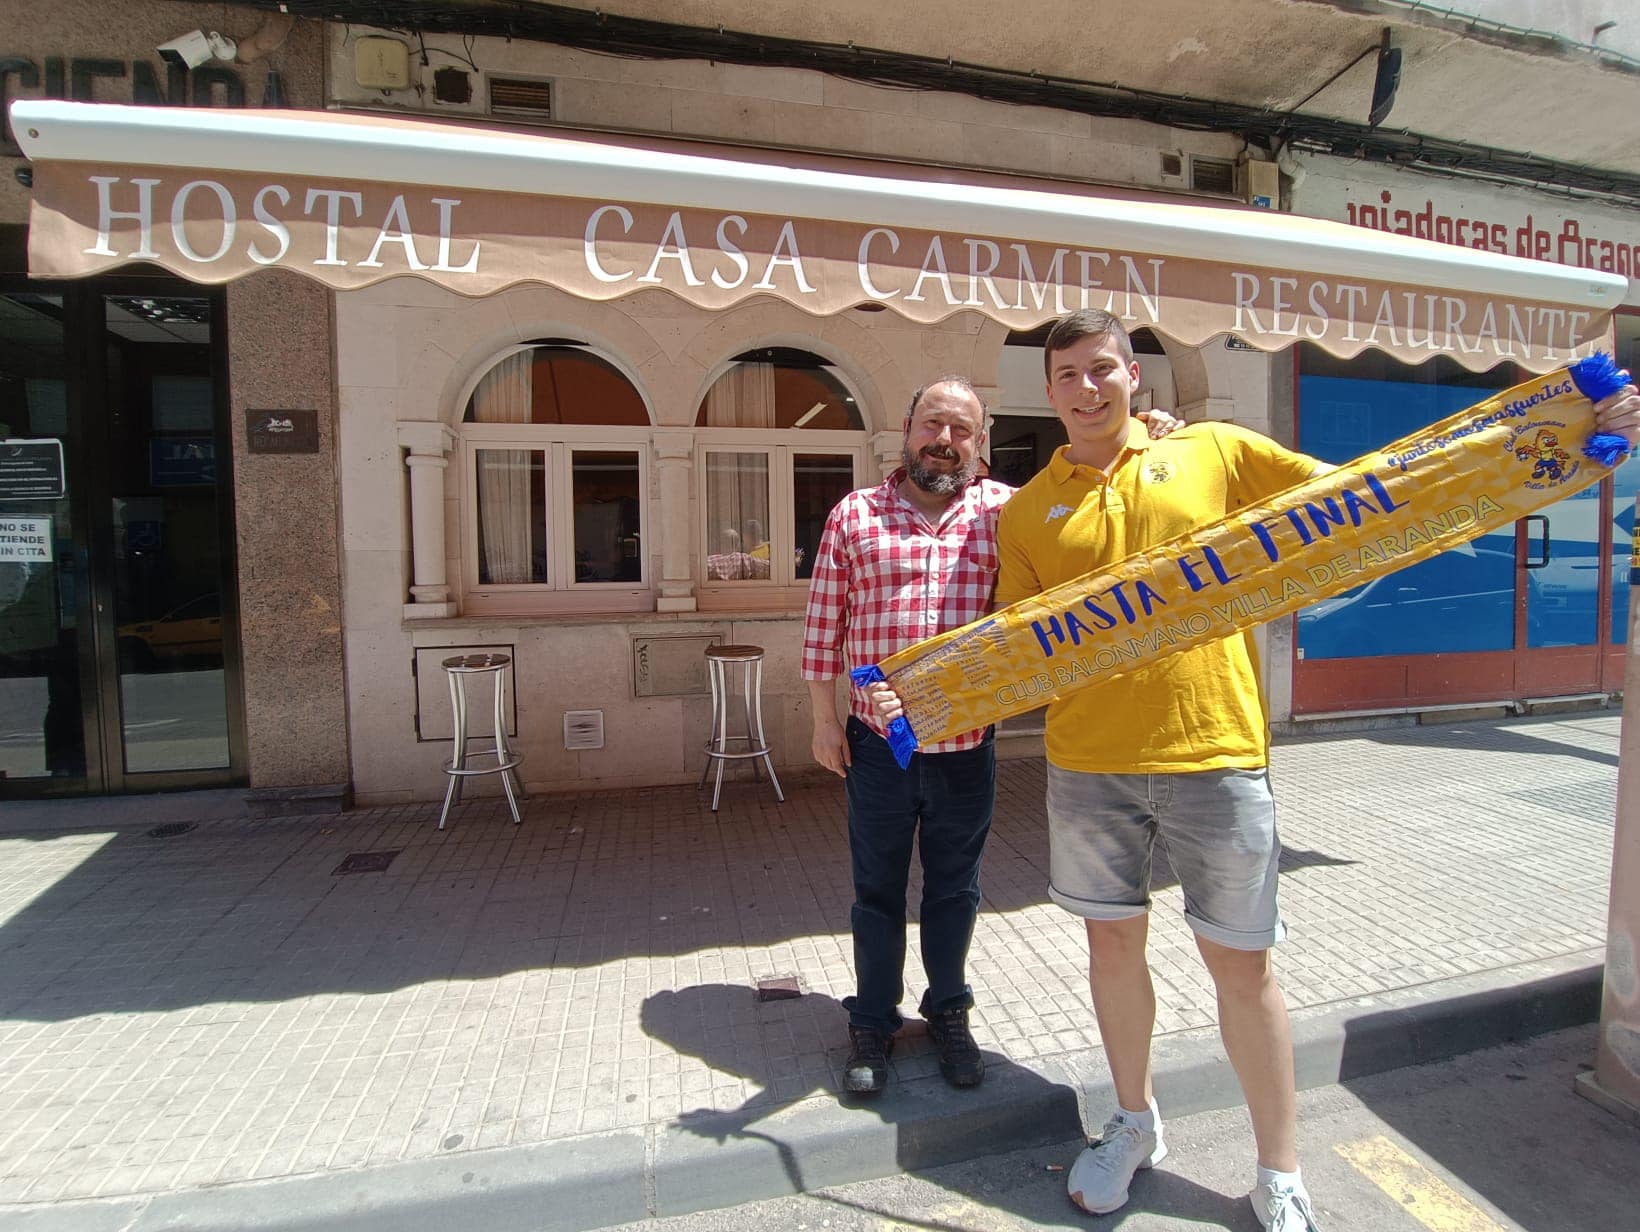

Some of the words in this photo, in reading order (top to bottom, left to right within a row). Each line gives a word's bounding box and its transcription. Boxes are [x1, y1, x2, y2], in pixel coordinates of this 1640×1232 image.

[82, 175, 481, 273] HOSTAL
[584, 205, 817, 293] CASA
[858, 228, 1165, 323] CARMEN
[1231, 272, 1594, 361] RESTAURANTE
[17, 547, 46, 556] CITA
[20, 523, 36, 531] SE
[996, 673, 1055, 705] CLUB
[1055, 613, 1211, 686] BALONMANO
[1212, 576, 1305, 625] VILLA
[1306, 554, 1352, 589] DE
[1358, 495, 1504, 571] ARANDA
[1031, 580, 1167, 657] HASTA
[1177, 546, 1242, 592] EL
[1250, 473, 1410, 562] FINAL
